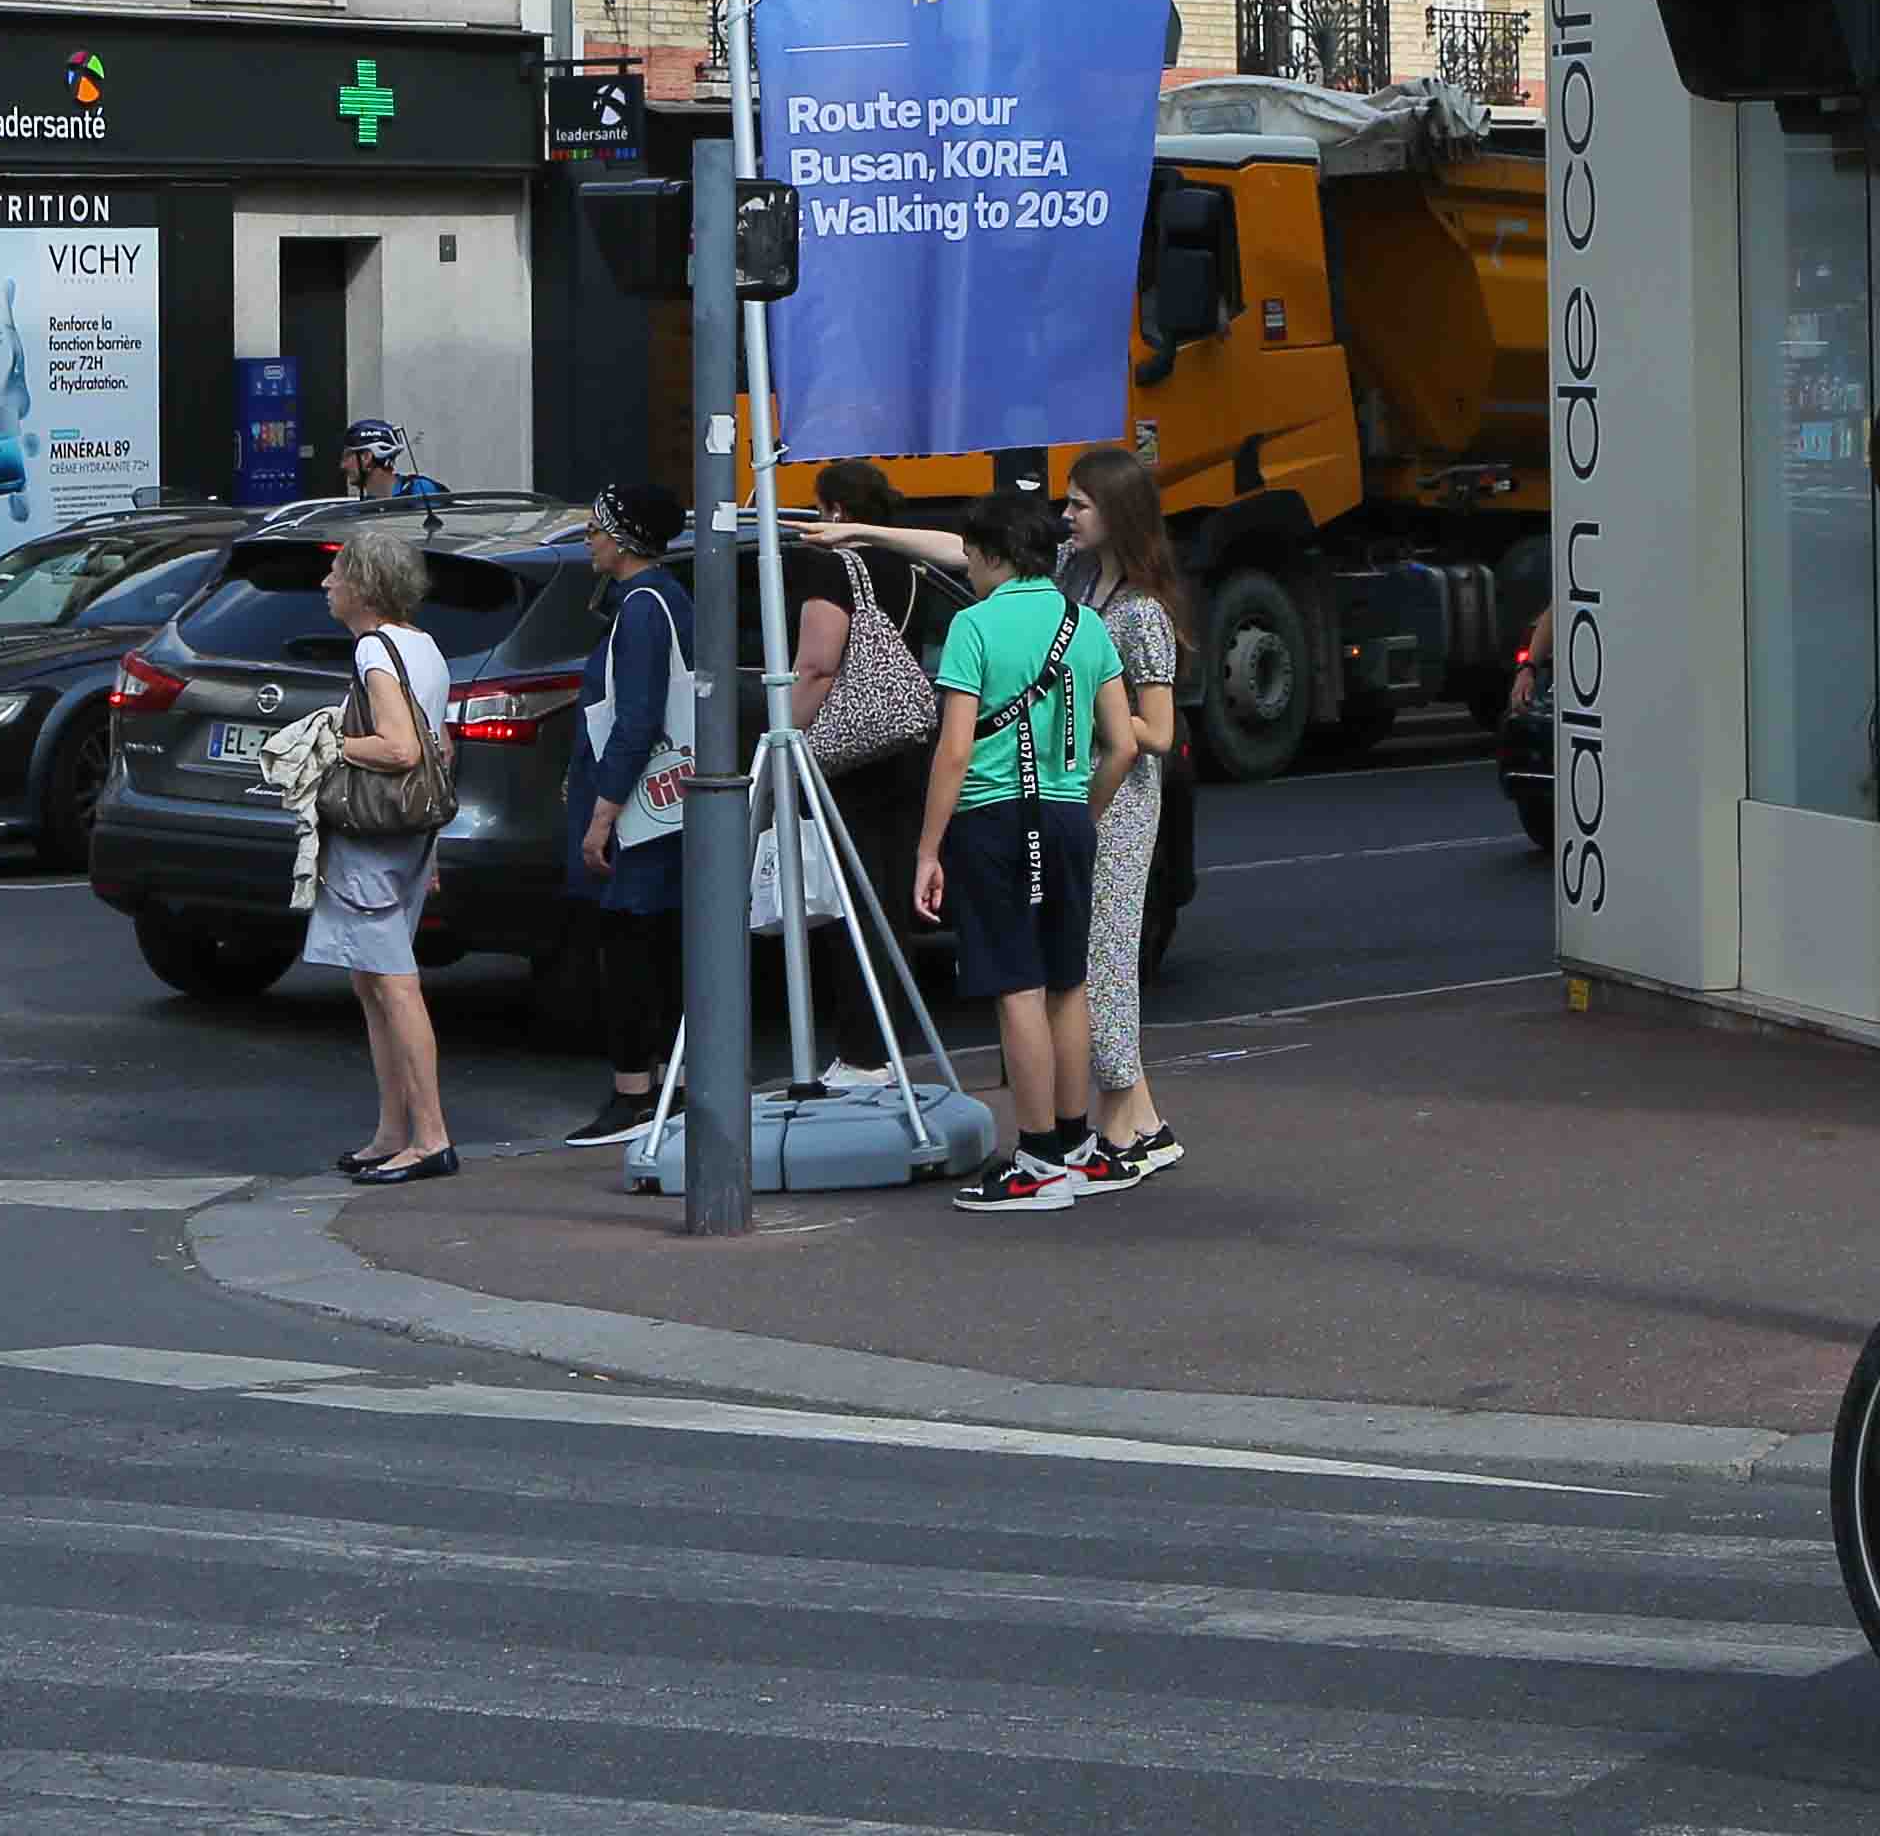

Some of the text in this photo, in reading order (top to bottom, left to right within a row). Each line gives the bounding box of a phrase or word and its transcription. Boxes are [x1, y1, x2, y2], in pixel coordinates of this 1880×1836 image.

[788, 92, 1018, 136] Route pour
[790, 140, 1069, 187] Busan, KOREA
[810, 193, 967, 242] Walking
[974, 192, 1010, 229] to
[1014, 190, 1109, 228] 2030
[48, 244, 142, 275] VICHY
[49, 315, 112, 332] Renforce la
[49, 334, 142, 351] fonction barrière
[49, 355, 103, 376] pour 72H
[49, 374, 129, 395] d'hydratation.
[1557, 287, 1599, 481] de
[50, 437, 131, 460] MINÉRAL 89
[1018, 722, 1036, 799] 0907MSTL
